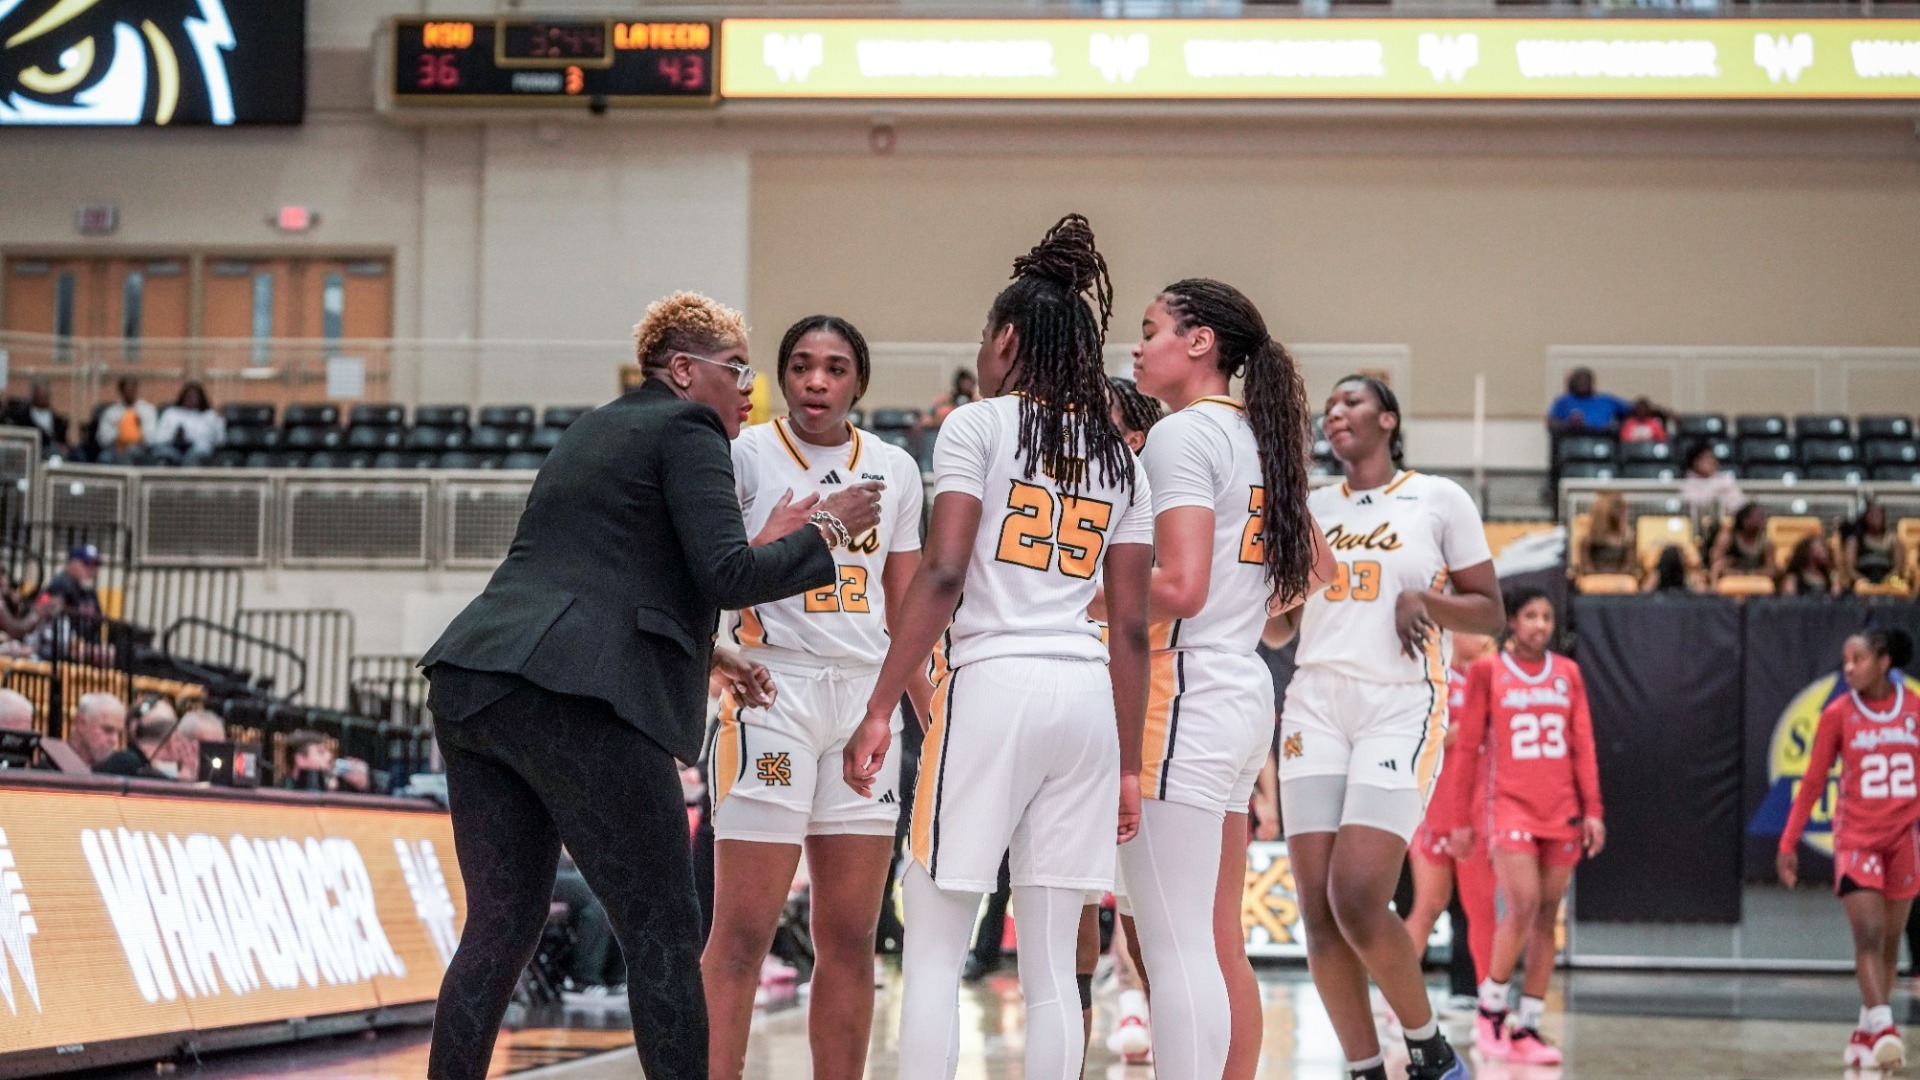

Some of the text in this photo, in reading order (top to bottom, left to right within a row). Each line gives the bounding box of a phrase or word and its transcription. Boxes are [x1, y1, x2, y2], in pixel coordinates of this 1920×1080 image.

[614, 22, 710, 49] LATECH
[417, 53, 460, 88] 36
[565, 65, 584, 95] 3
[658, 54, 704, 89] 43
[994, 478, 1113, 581] 25
[804, 564, 871, 613] 22
[1510, 712, 1568, 760] 23
[1859, 754, 1918, 799] 22
